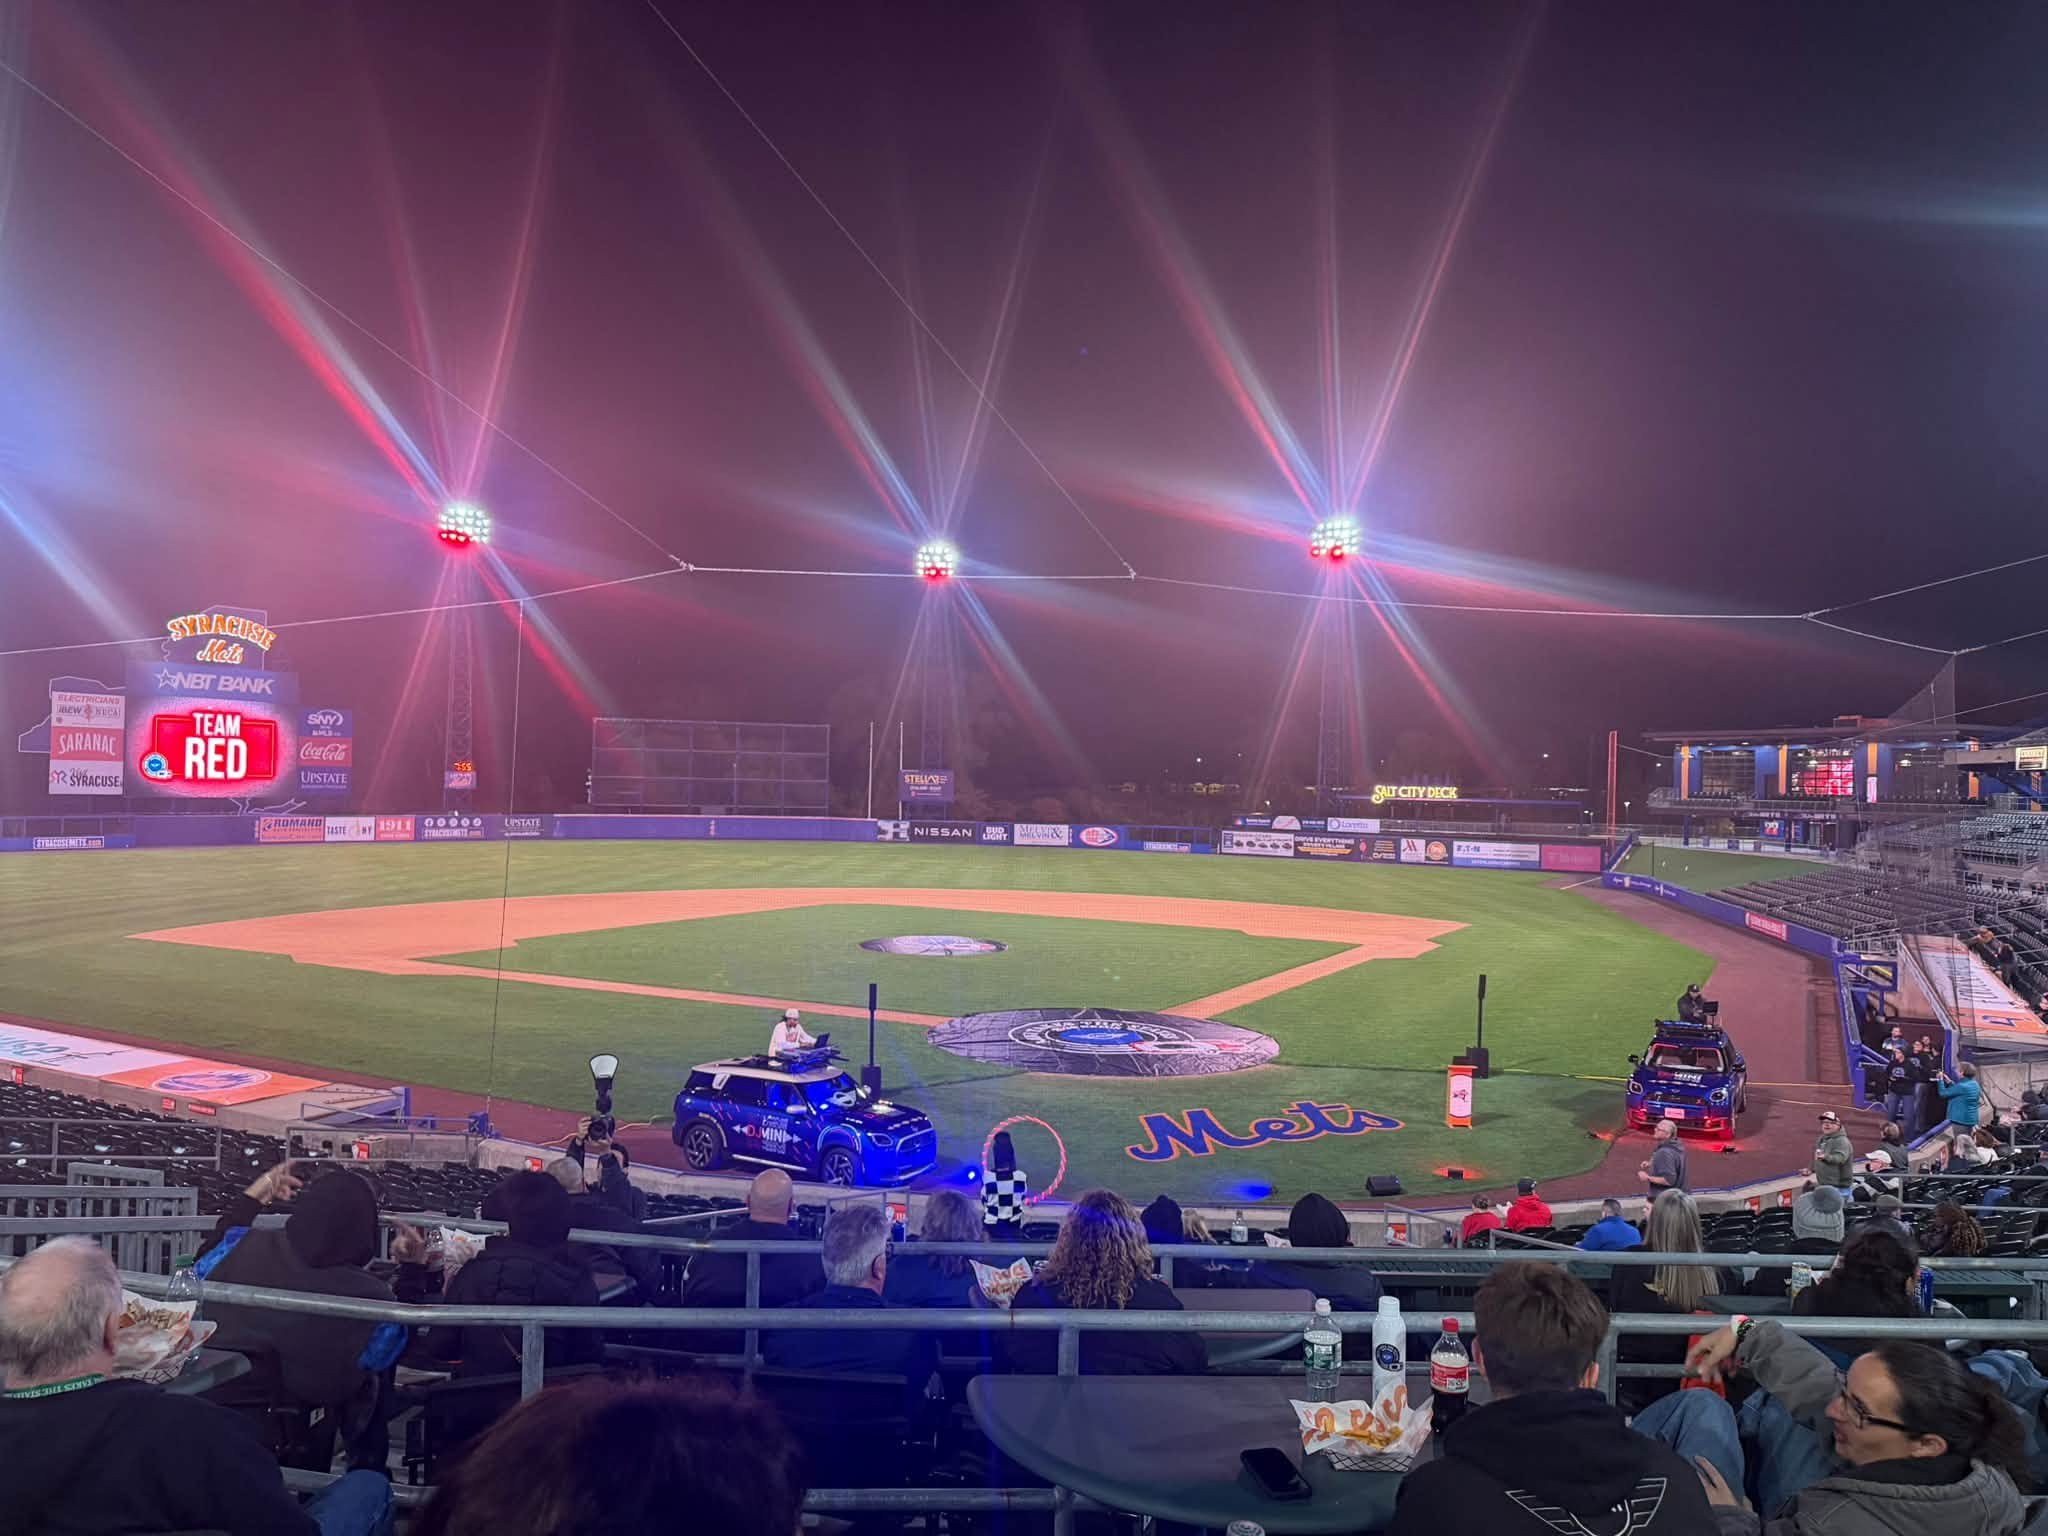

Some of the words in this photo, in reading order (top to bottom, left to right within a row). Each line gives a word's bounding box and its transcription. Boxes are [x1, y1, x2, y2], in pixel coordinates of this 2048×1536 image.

[167, 614, 277, 651] SYRACUSE
[196, 638, 244, 664] Mets
[176, 672, 216, 690] NBT
[218, 675, 274, 694] BANK
[192, 712, 241, 736] TEAM
[307, 713, 337, 725] SNY
[58, 732, 117, 757] SARANAC
[184, 736, 248, 779] RED
[301, 771, 348, 784] UPSTATE
[1371, 784, 1397, 804] SALT
[1398, 786, 1425, 798] CITY
[1427, 787, 1458, 799] DECK
[327, 825, 346, 835] TASTE
[504, 818, 541, 827] UPSTATE
[914, 827, 973, 837] NISSAN
[982, 832, 1008, 841] LIGHT
[1125, 1101, 1406, 1162] Mets
